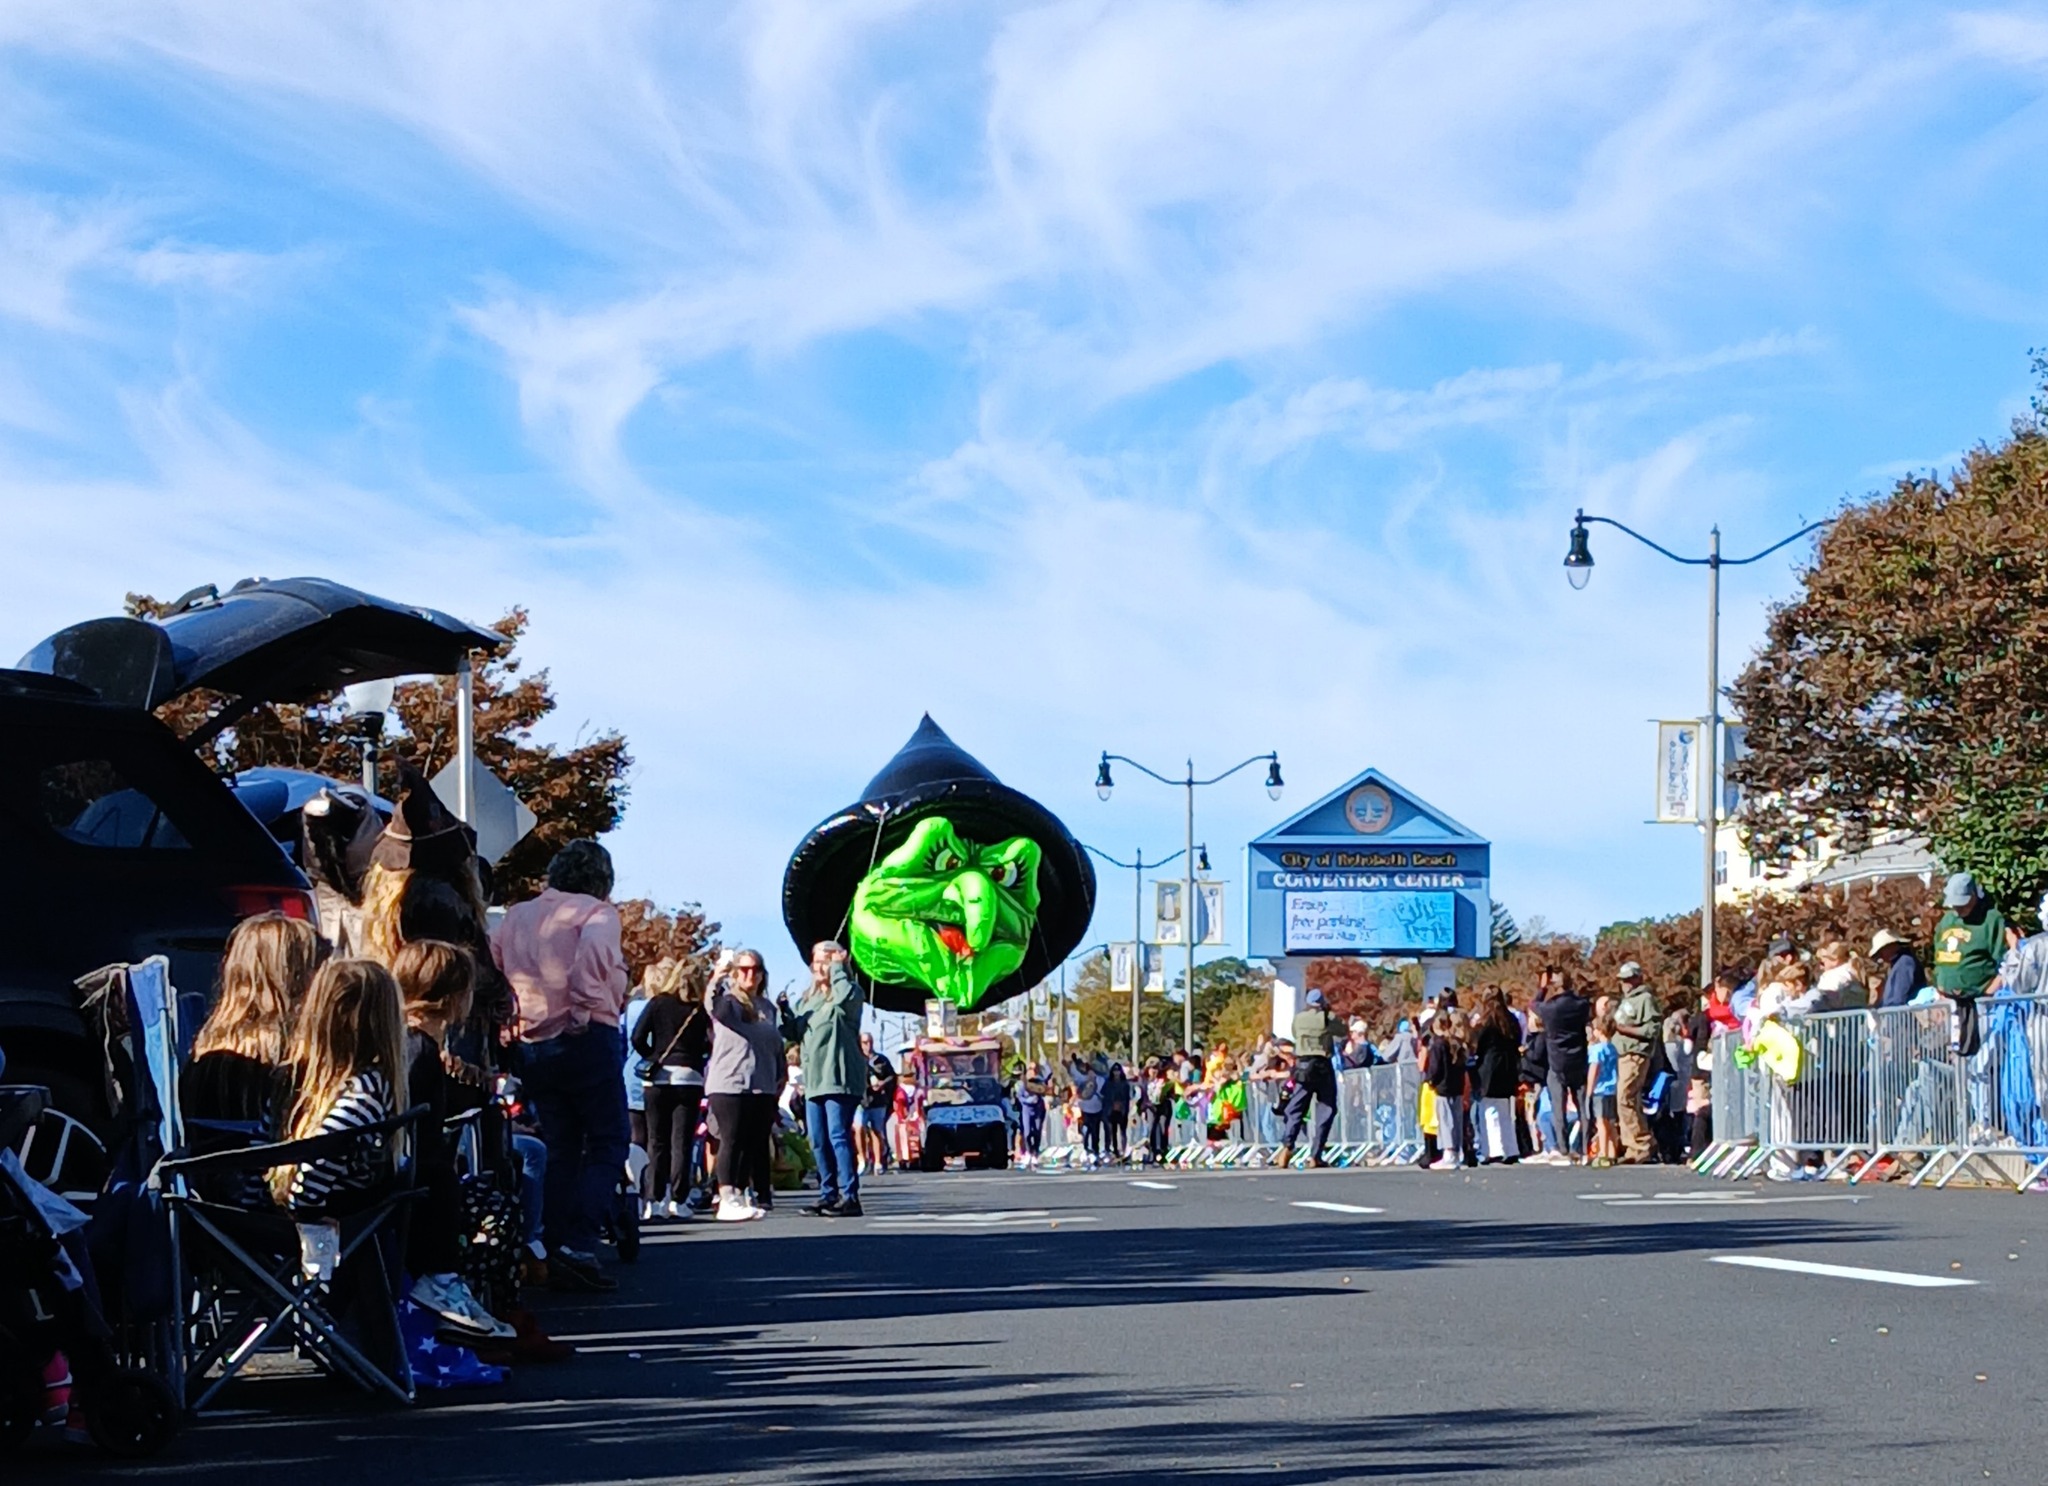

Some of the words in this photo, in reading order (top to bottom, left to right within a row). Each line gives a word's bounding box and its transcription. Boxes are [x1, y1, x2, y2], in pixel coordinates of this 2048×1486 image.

[1281, 853, 1309, 868] City
[1316, 853, 1330, 866] of
[1338, 853, 1406, 866] Rehoboth
[1412, 853, 1456, 866] Beach
[1273, 873, 1387, 887] CONVENTION
[1393, 873, 1465, 887] CENTER
